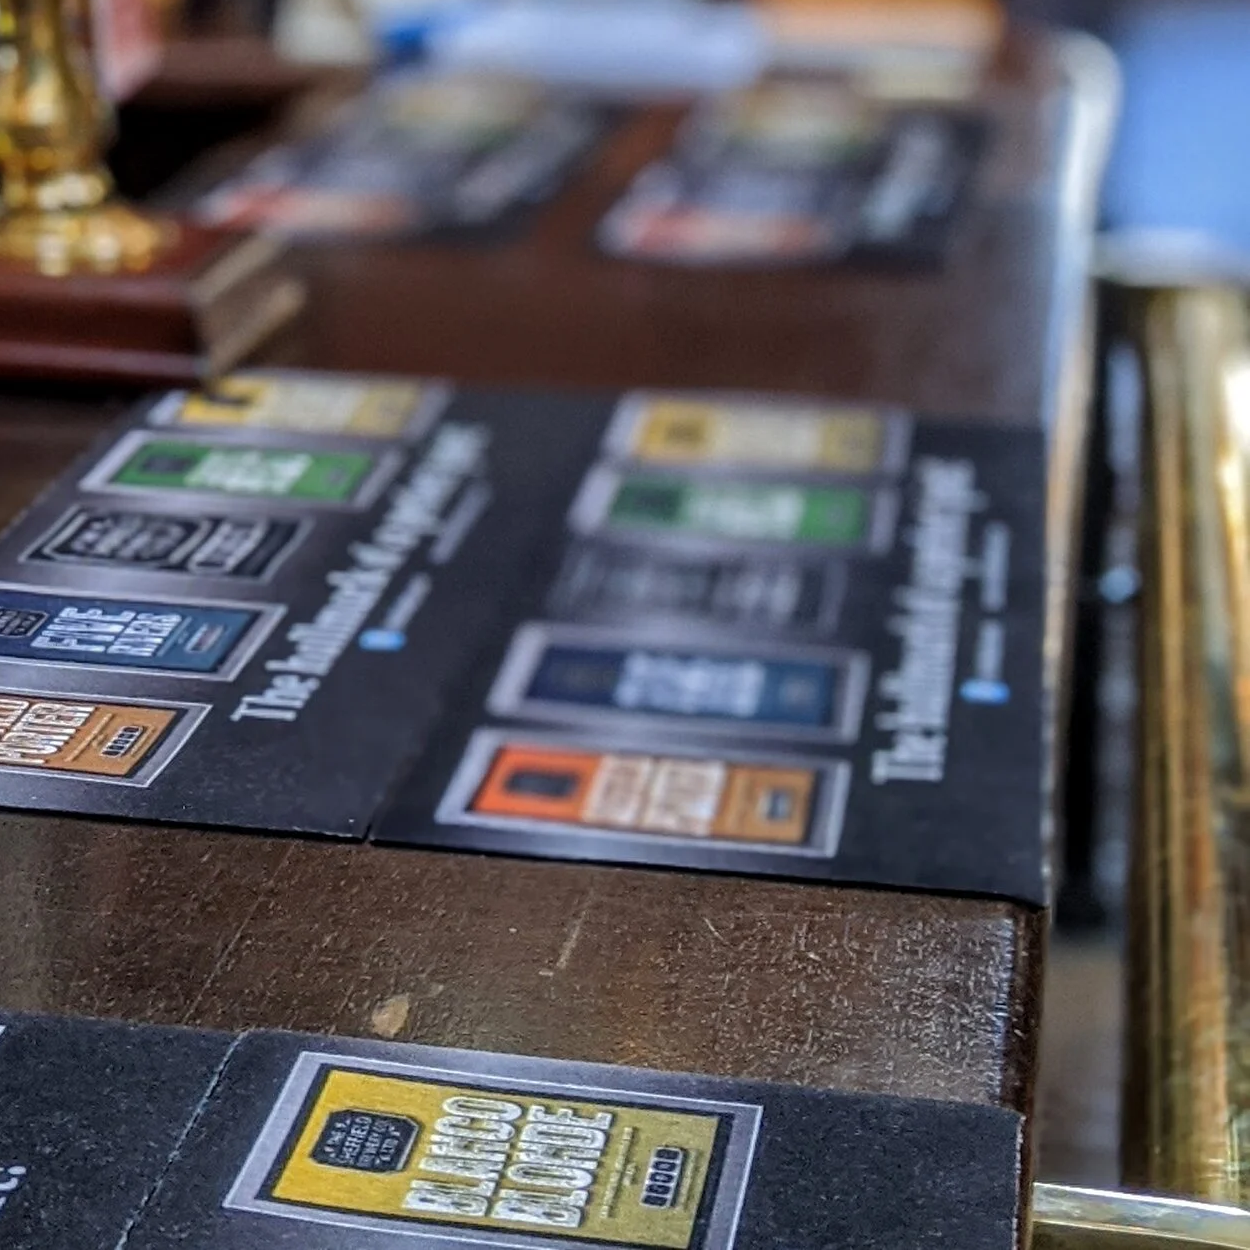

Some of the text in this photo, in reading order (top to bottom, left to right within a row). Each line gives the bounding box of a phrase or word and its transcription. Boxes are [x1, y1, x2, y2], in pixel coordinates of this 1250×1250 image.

[30, 605, 137, 653] FIVE
[402, 1095, 524, 1217] BLANCO
[486, 1104, 616, 1229] BLONDE
